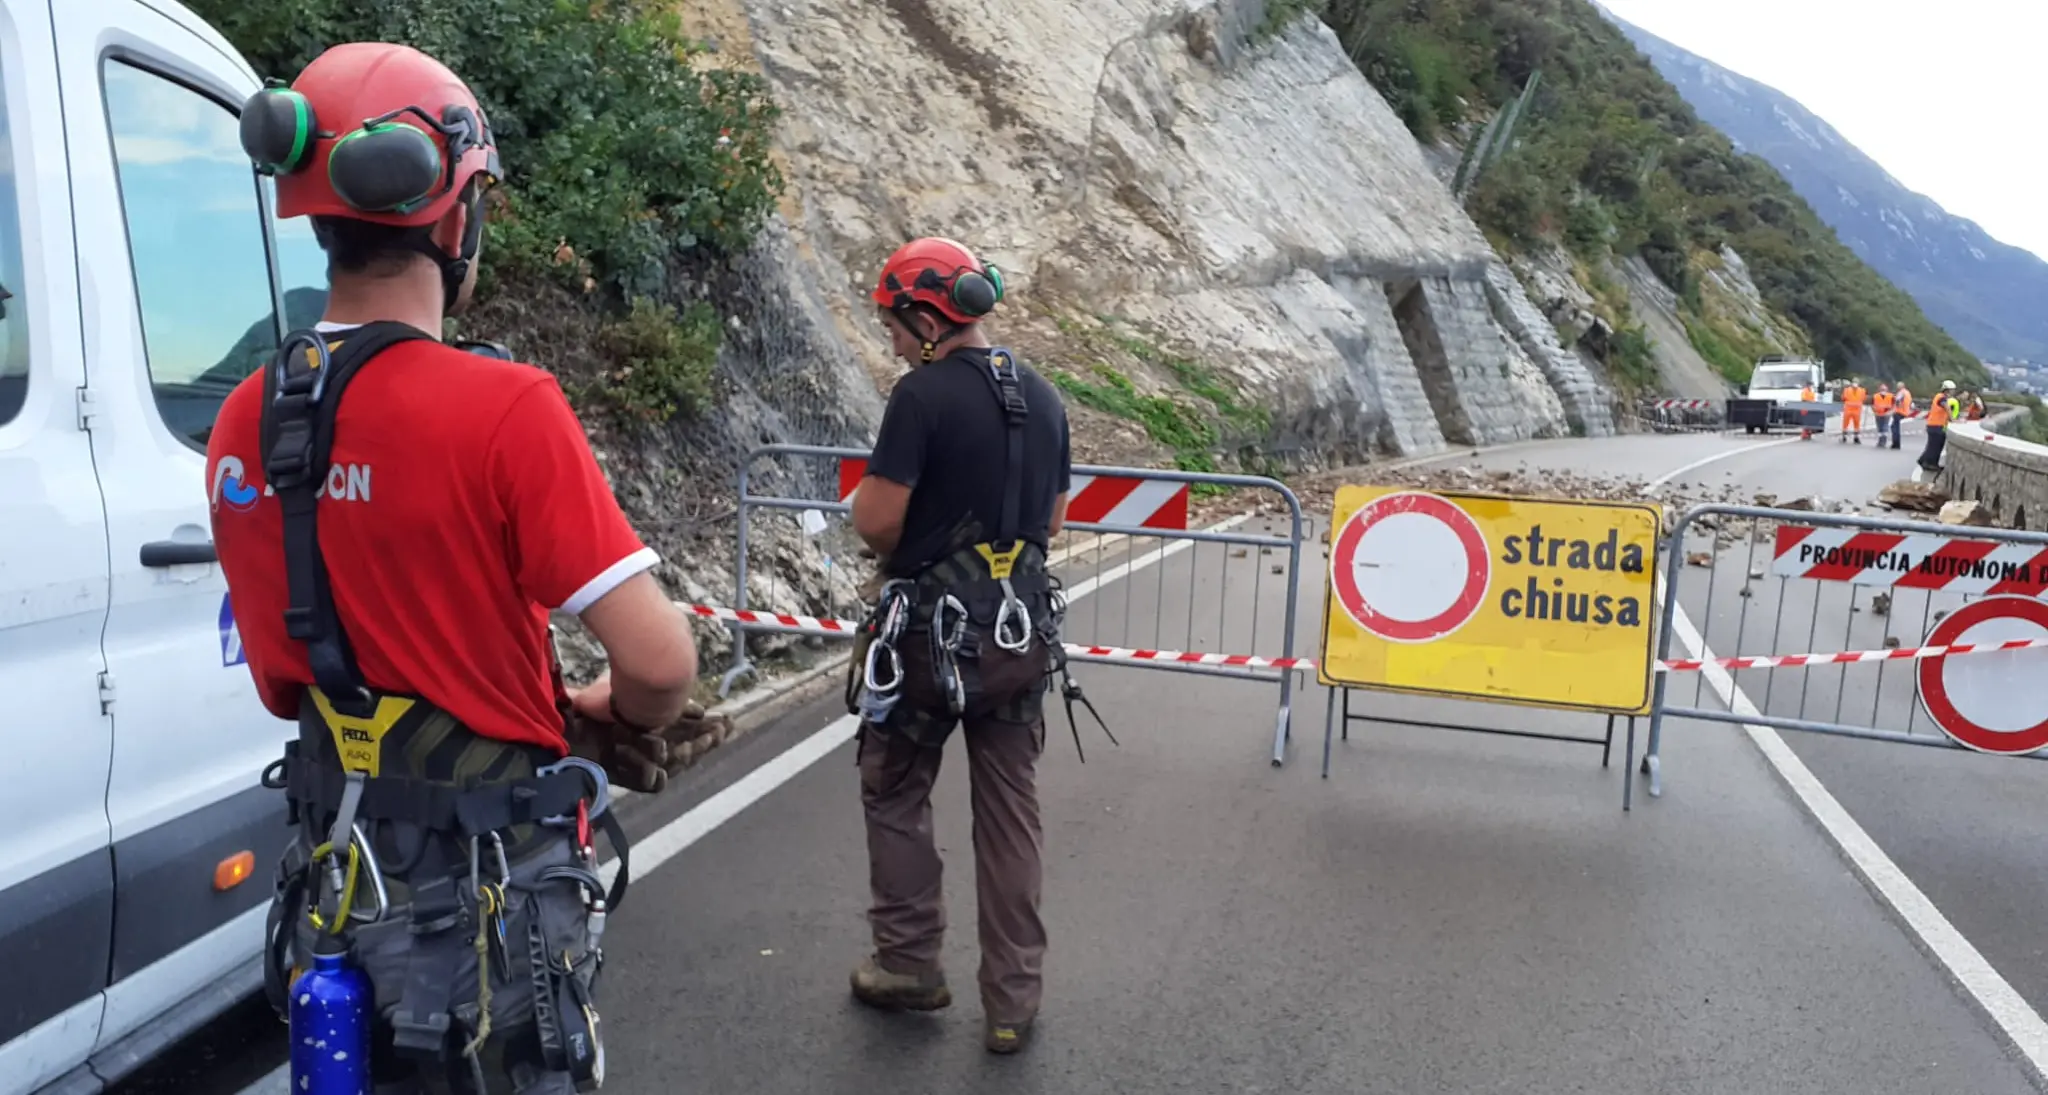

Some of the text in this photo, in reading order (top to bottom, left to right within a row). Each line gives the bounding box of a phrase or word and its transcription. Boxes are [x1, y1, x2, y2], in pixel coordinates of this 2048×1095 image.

[1501, 524, 1645, 574] strada
[1799, 543, 1910, 573] PROVINCIA
[1919, 554, 2030, 584] AUTONOMA
[1500, 576, 1641, 627] chiusa
